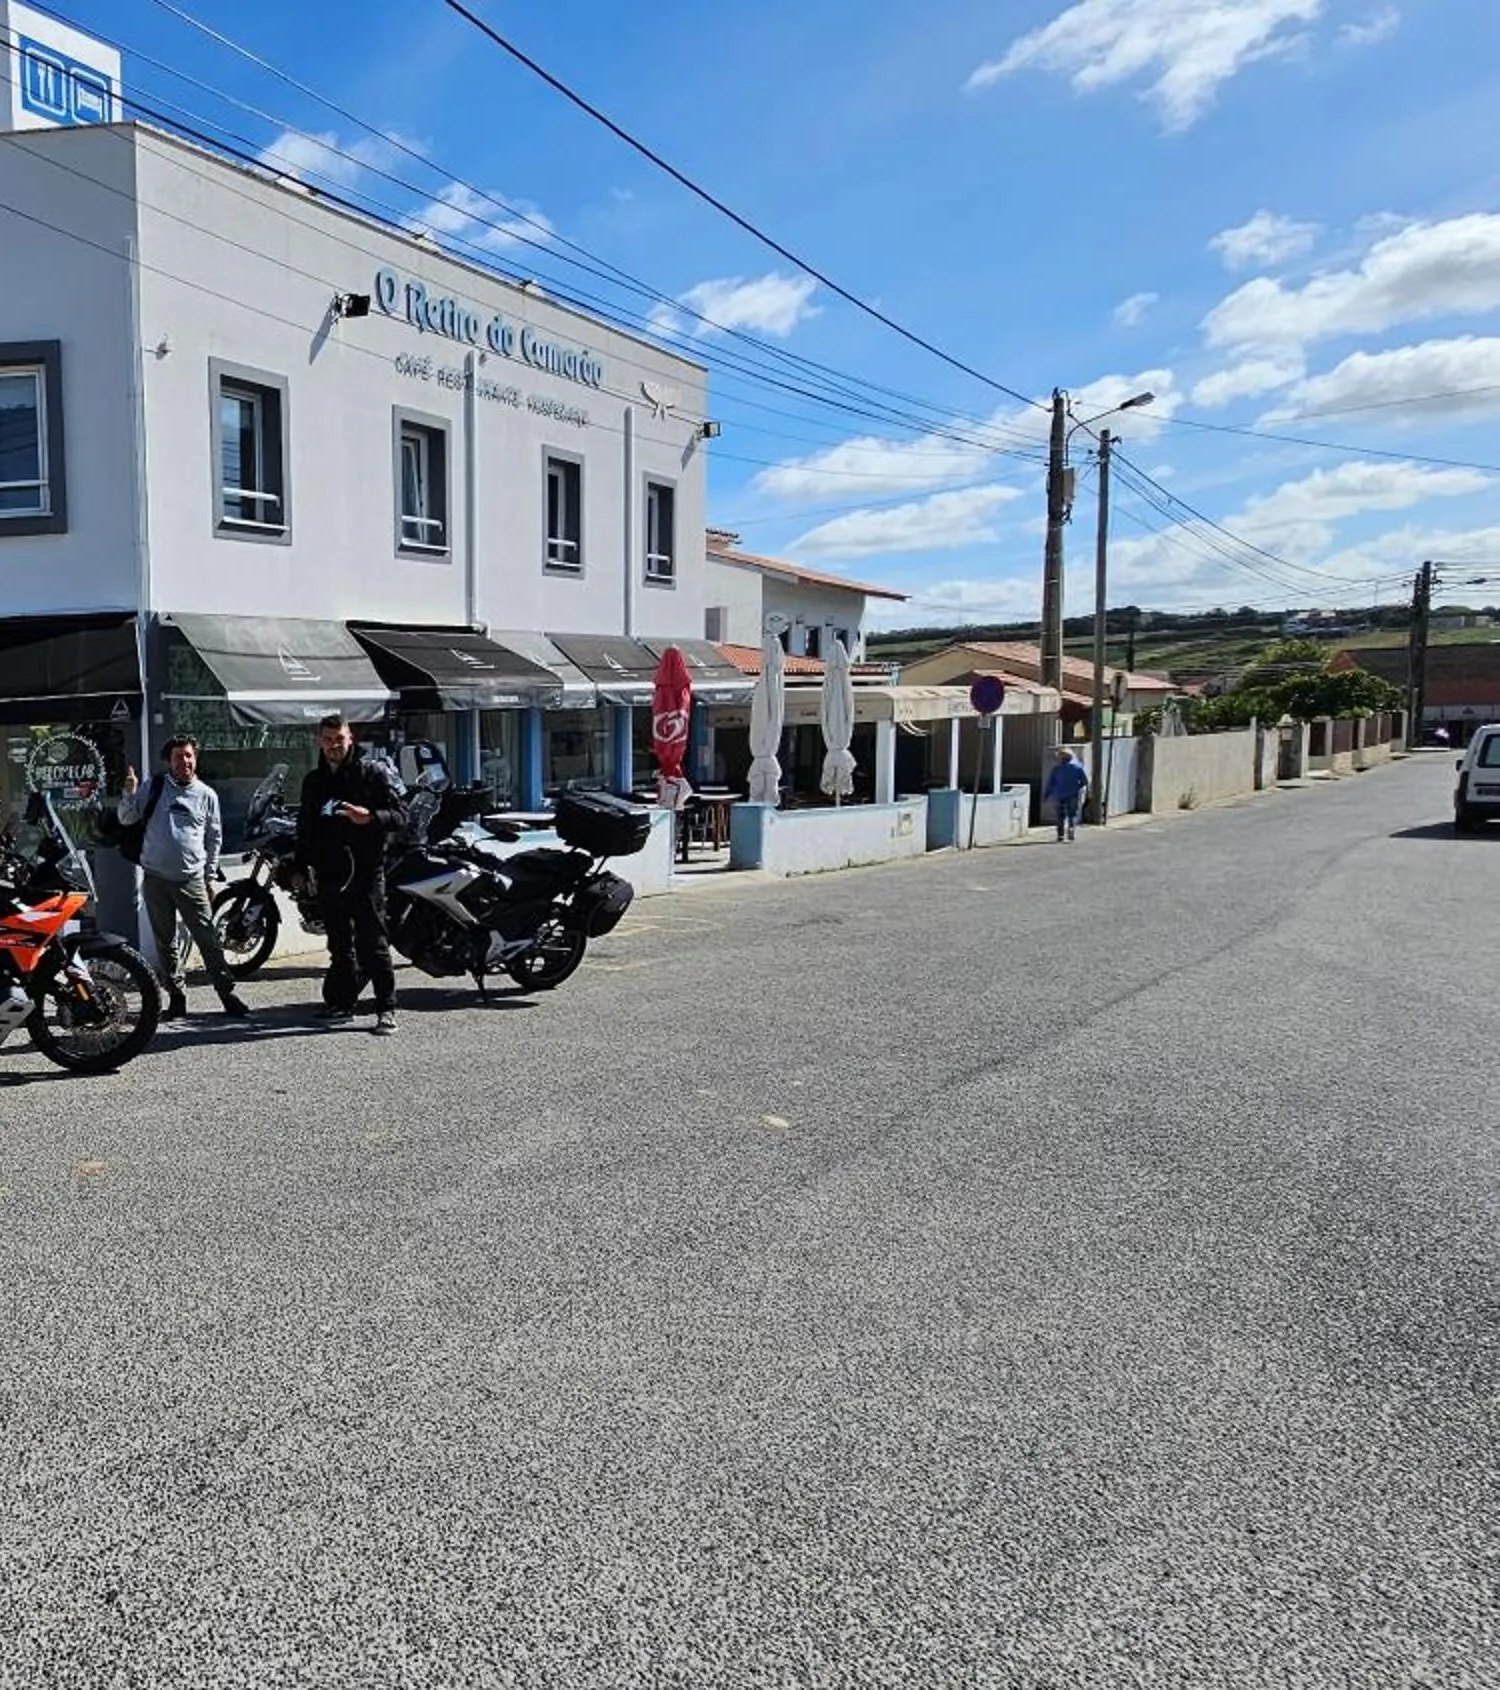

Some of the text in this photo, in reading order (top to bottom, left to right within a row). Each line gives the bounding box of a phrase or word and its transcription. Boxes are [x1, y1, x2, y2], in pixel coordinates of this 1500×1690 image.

[374, 266, 400, 315] O
[404, 280, 483, 345] Retiro
[487, 314, 514, 357] do
